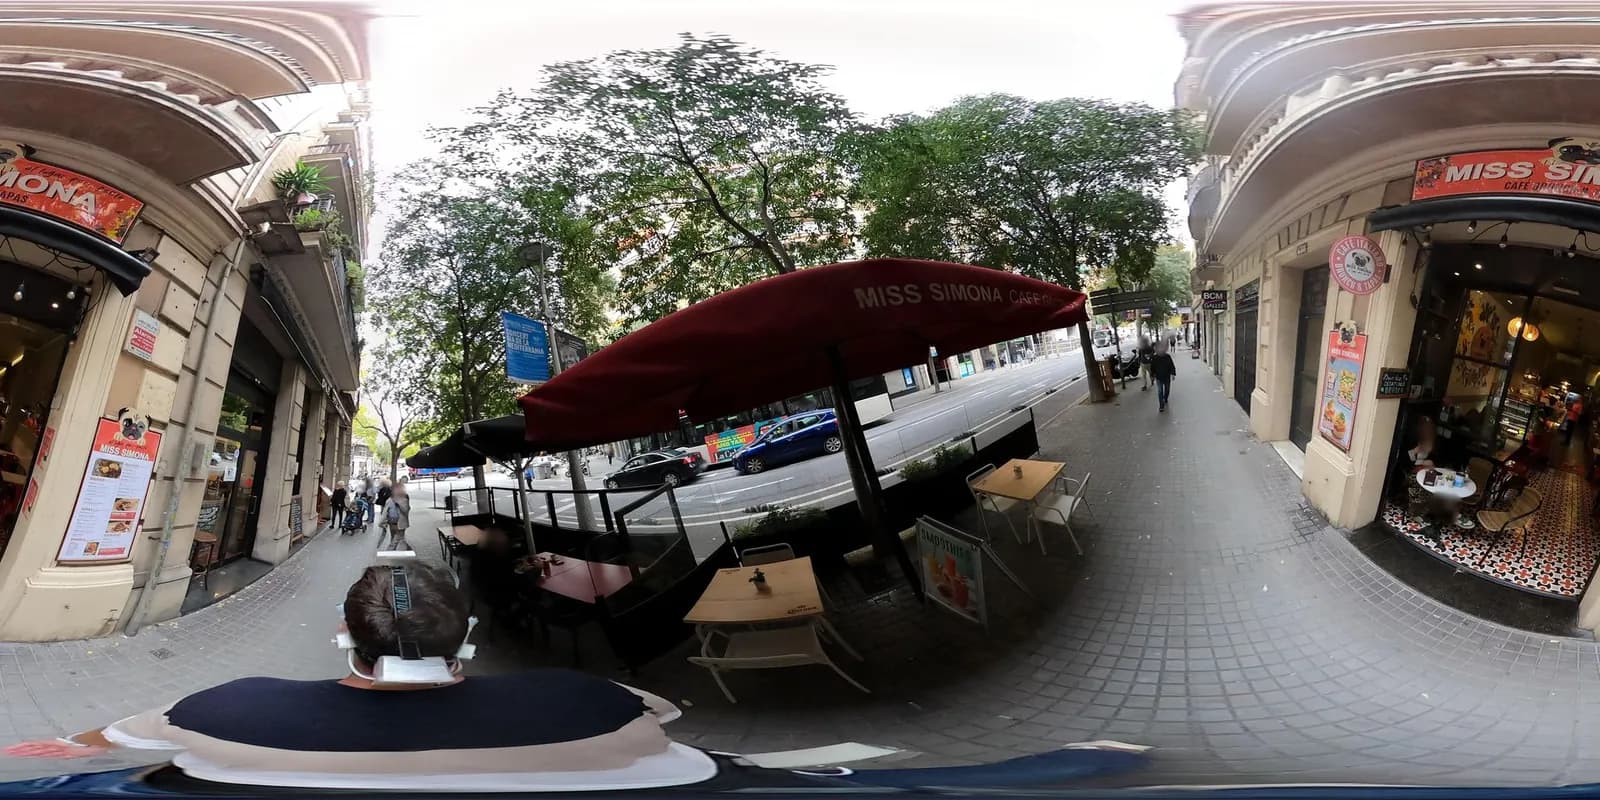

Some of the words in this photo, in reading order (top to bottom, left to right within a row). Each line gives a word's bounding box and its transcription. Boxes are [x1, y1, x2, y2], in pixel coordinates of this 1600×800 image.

[1445, 161, 1534, 183] MISS
[853, 284, 922, 309] MISS
[929, 282, 1003, 303] SIMONA
[1203, 292, 1223, 300] BCM
[101, 444, 121, 456] MISS
[121, 448, 150, 460] SIMONA
